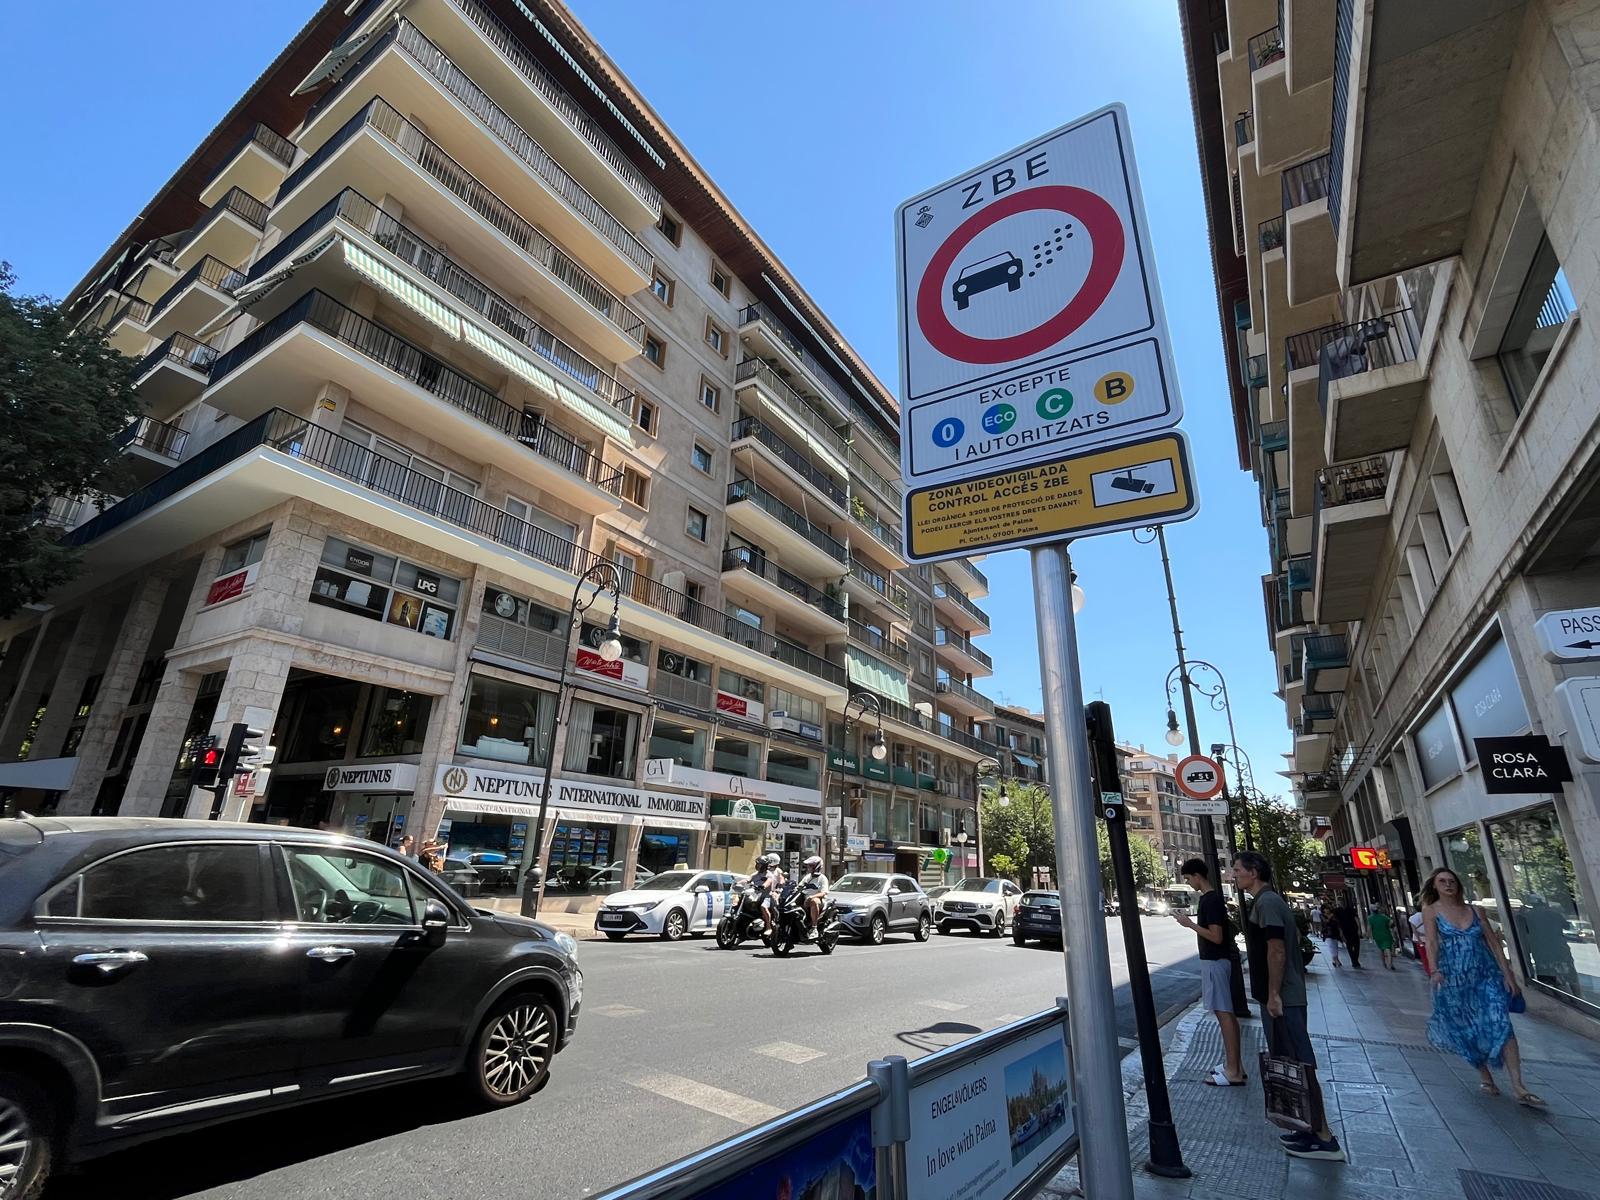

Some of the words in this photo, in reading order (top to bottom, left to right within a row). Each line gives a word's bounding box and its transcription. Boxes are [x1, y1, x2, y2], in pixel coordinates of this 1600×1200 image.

[961, 152, 1050, 210] ZBE
[979, 367, 1071, 404] EXCEPTE
[941, 423, 955, 442] 0
[984, 410, 1015, 427] ECO
[1044, 394, 1064, 413] C
[1104, 377, 1127, 400] B
[955, 448, 960, 460] I
[966, 410, 1110, 459] AUTORITZATS
[928, 488, 963, 502] ZONA
[966, 463, 1068, 492] VIDEOVIGILADA
[928, 493, 988, 512] CONTROL
[993, 481, 1039, 500] ACCÉS
[1043, 475, 1070, 489] ZBE
[917, 519, 931, 527] LLEI
[1002, 496, 1043, 510] PROTECCIÓ
[1057, 488, 1083, 499] DADES
[921, 525, 943, 534] PODEU
[974, 516, 987, 524] ELS
[989, 510, 1020, 521] VOSTRES
[1022, 505, 1046, 515] DRETS
[963, 523, 1000, 535] Ajuntament
[1012, 518, 1033, 526] Palma
[1017, 526, 1038, 534] Palma
[417, 578, 437, 593] LPG
[340, 769, 392, 784] NEPTUNUS
[1492, 752, 1539, 764] ROSA
[559, 786, 642, 808] INTERNATIONAL
[647, 796, 704, 814] IMMOBILIEN
[931, 1076, 988, 1119] ENGEL&VÖLKERS
[926, 1155, 937, 1178] In
[937, 1147, 956, 1170] love
[956, 1128, 975, 1155] with
[975, 1119, 996, 1145] Palma
